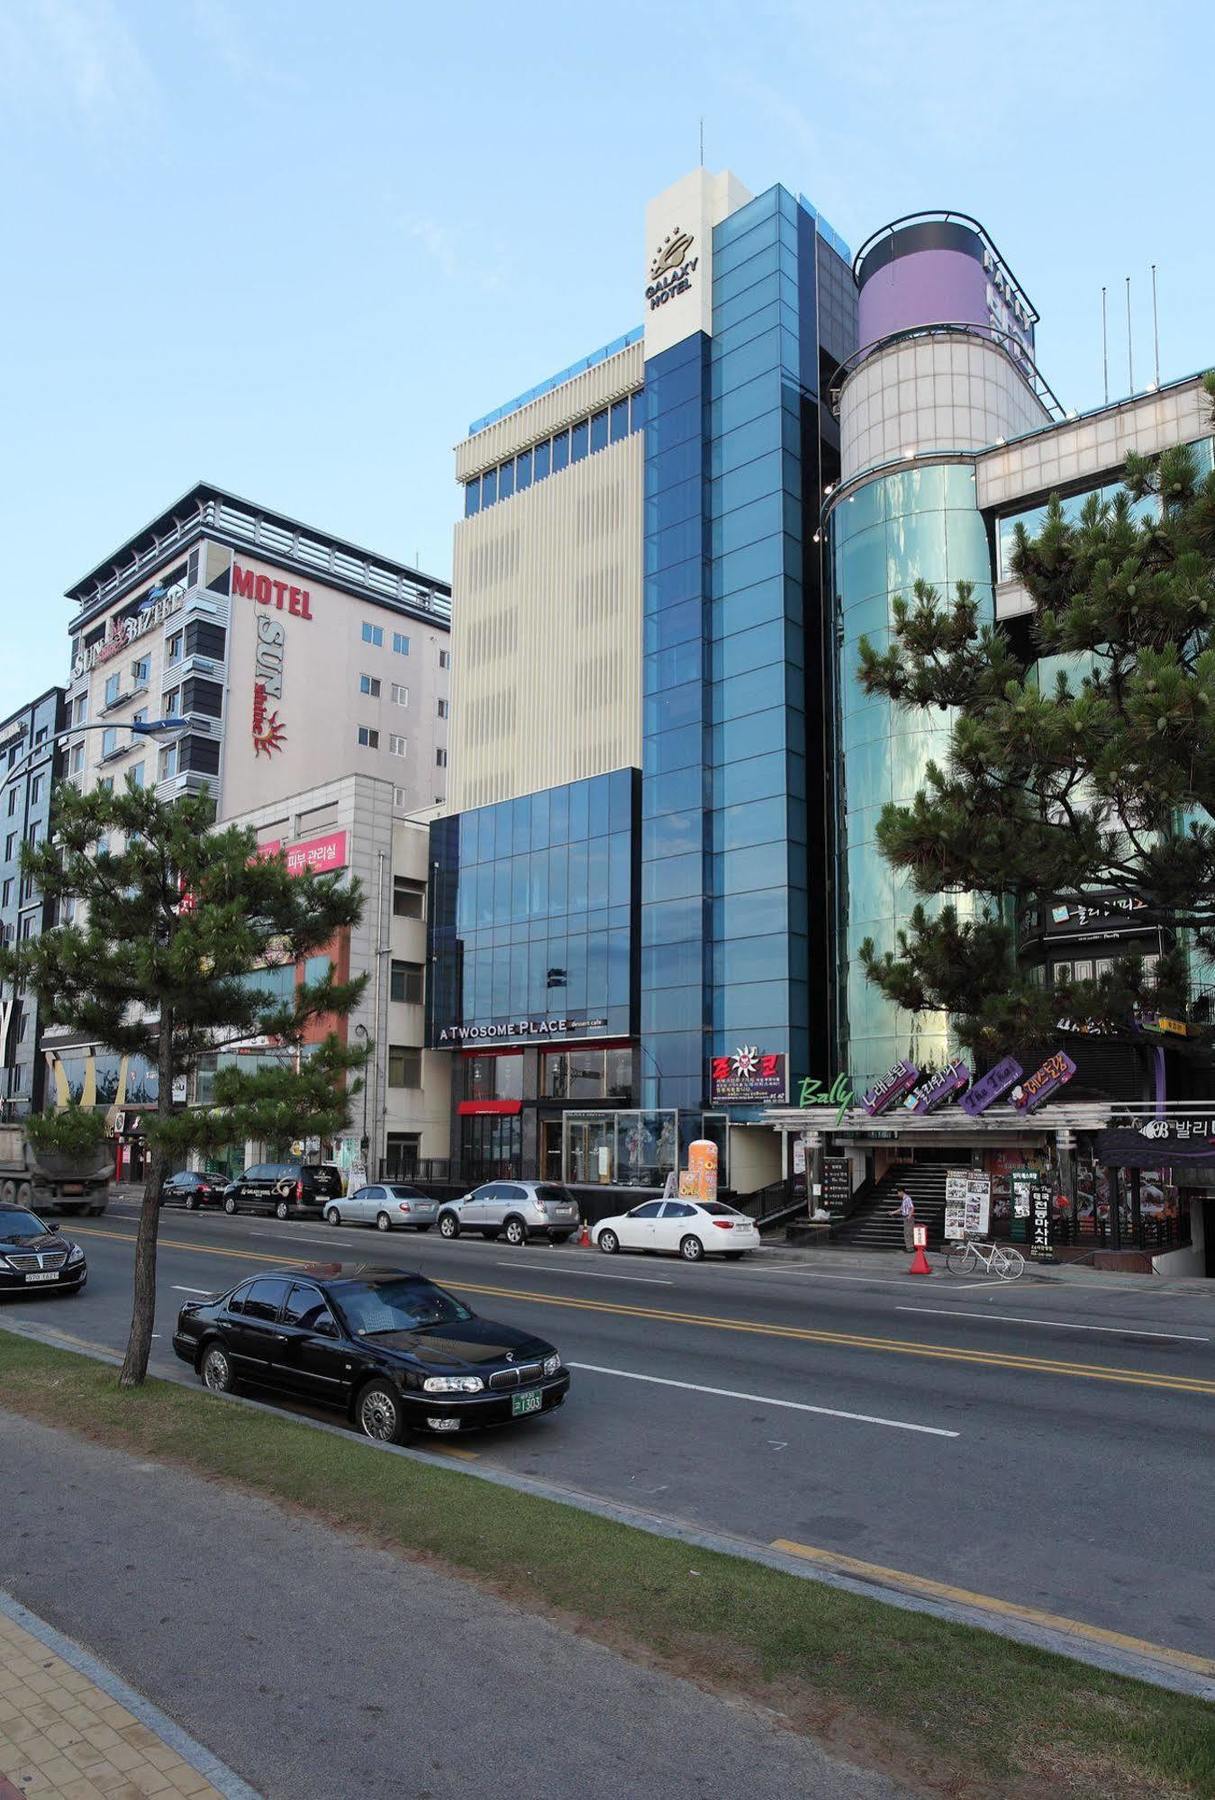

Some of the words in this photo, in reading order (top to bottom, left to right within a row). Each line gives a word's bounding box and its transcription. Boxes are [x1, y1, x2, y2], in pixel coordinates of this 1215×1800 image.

[645, 257, 698, 299] GALAXY
[651, 278, 692, 310] HOTEL
[983, 249, 1031, 332] BALLY
[232, 565, 313, 620] MOTEL
[70, 638, 106, 680] SUN
[256, 615, 285, 700] SUN
[288, 851, 306, 869] 피부
[307, 843, 336, 865] 관리실
[440, 1029, 449, 1041] A
[450, 1023, 515, 1040] TWOSOME
[519, 1019, 567, 1035] PLACE
[862, 1060, 908, 1107] 노래클럽
[1023, 1055, 1068, 1095] 레스토랑
[798, 1072, 853, 1126] Bally
